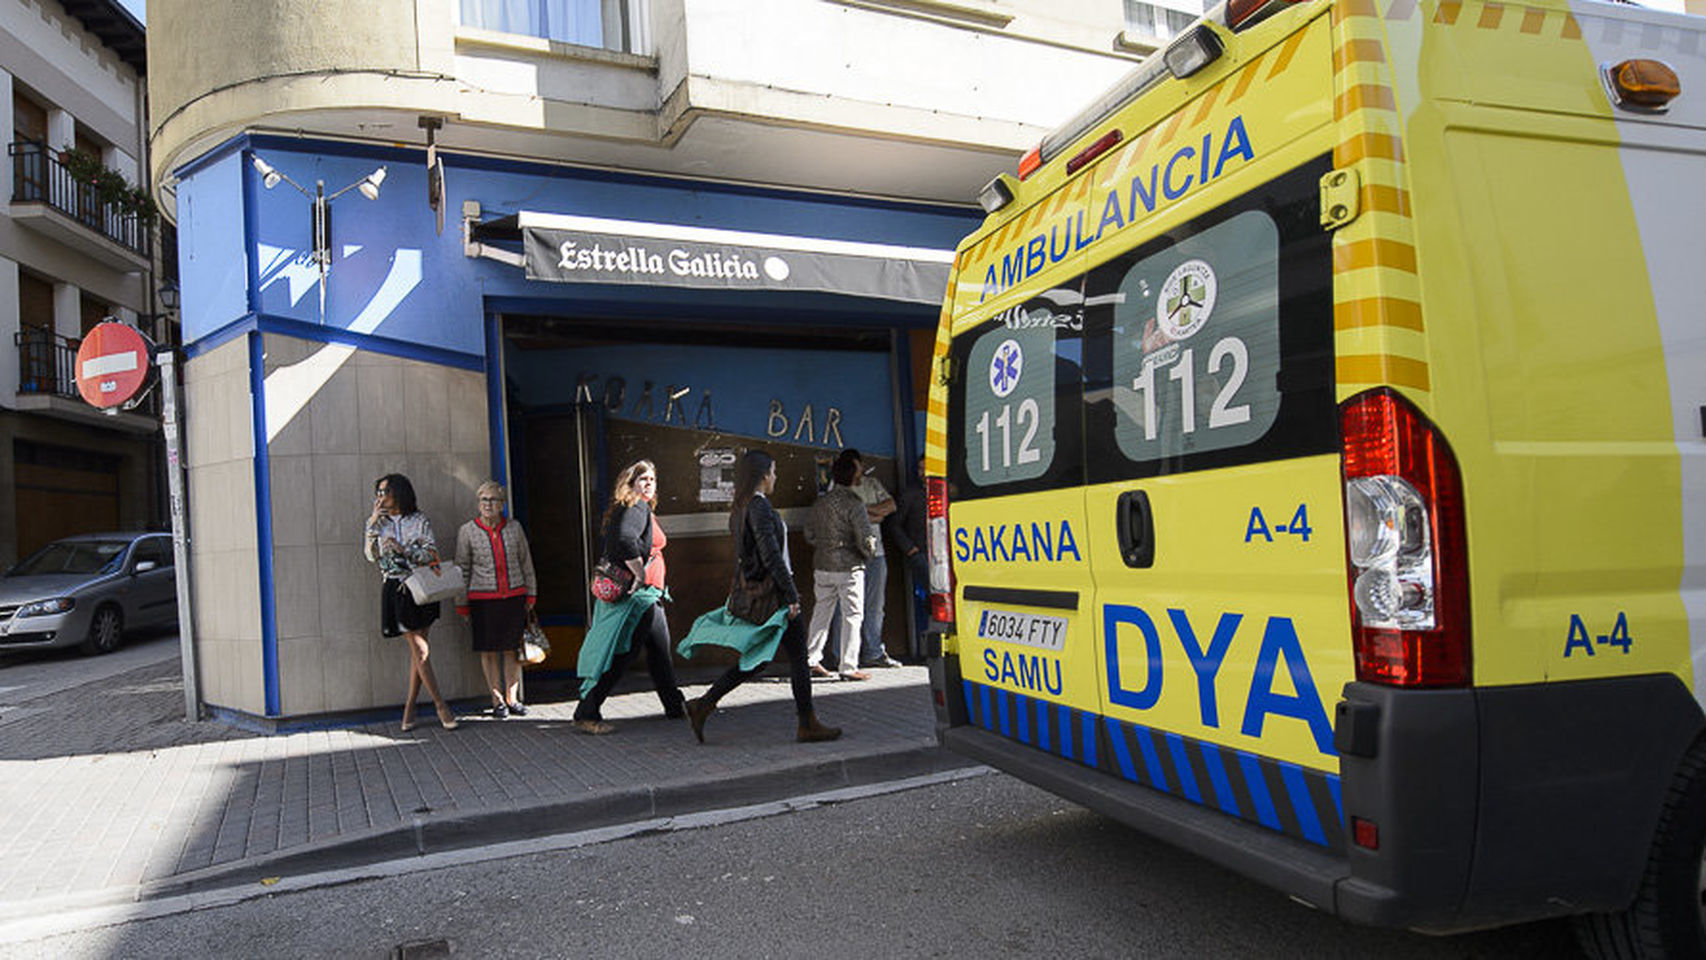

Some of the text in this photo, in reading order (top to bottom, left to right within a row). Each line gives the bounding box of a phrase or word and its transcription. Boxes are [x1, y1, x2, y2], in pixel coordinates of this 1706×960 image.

[980, 115, 1254, 303] AMBULANCIA
[558, 241, 759, 279] Estrella Galicia
[1133, 337, 1250, 441] 112
[766, 399, 844, 447] BAR
[976, 399, 1040, 471] 112
[955, 520, 1081, 563] SAKANA
[1244, 504, 1312, 543] A-4
[988, 614, 1062, 645] 6034 FTY
[1563, 611, 1632, 658] A-4
[984, 648, 1062, 695] SAMU
[1103, 604, 1341, 757] DYA
